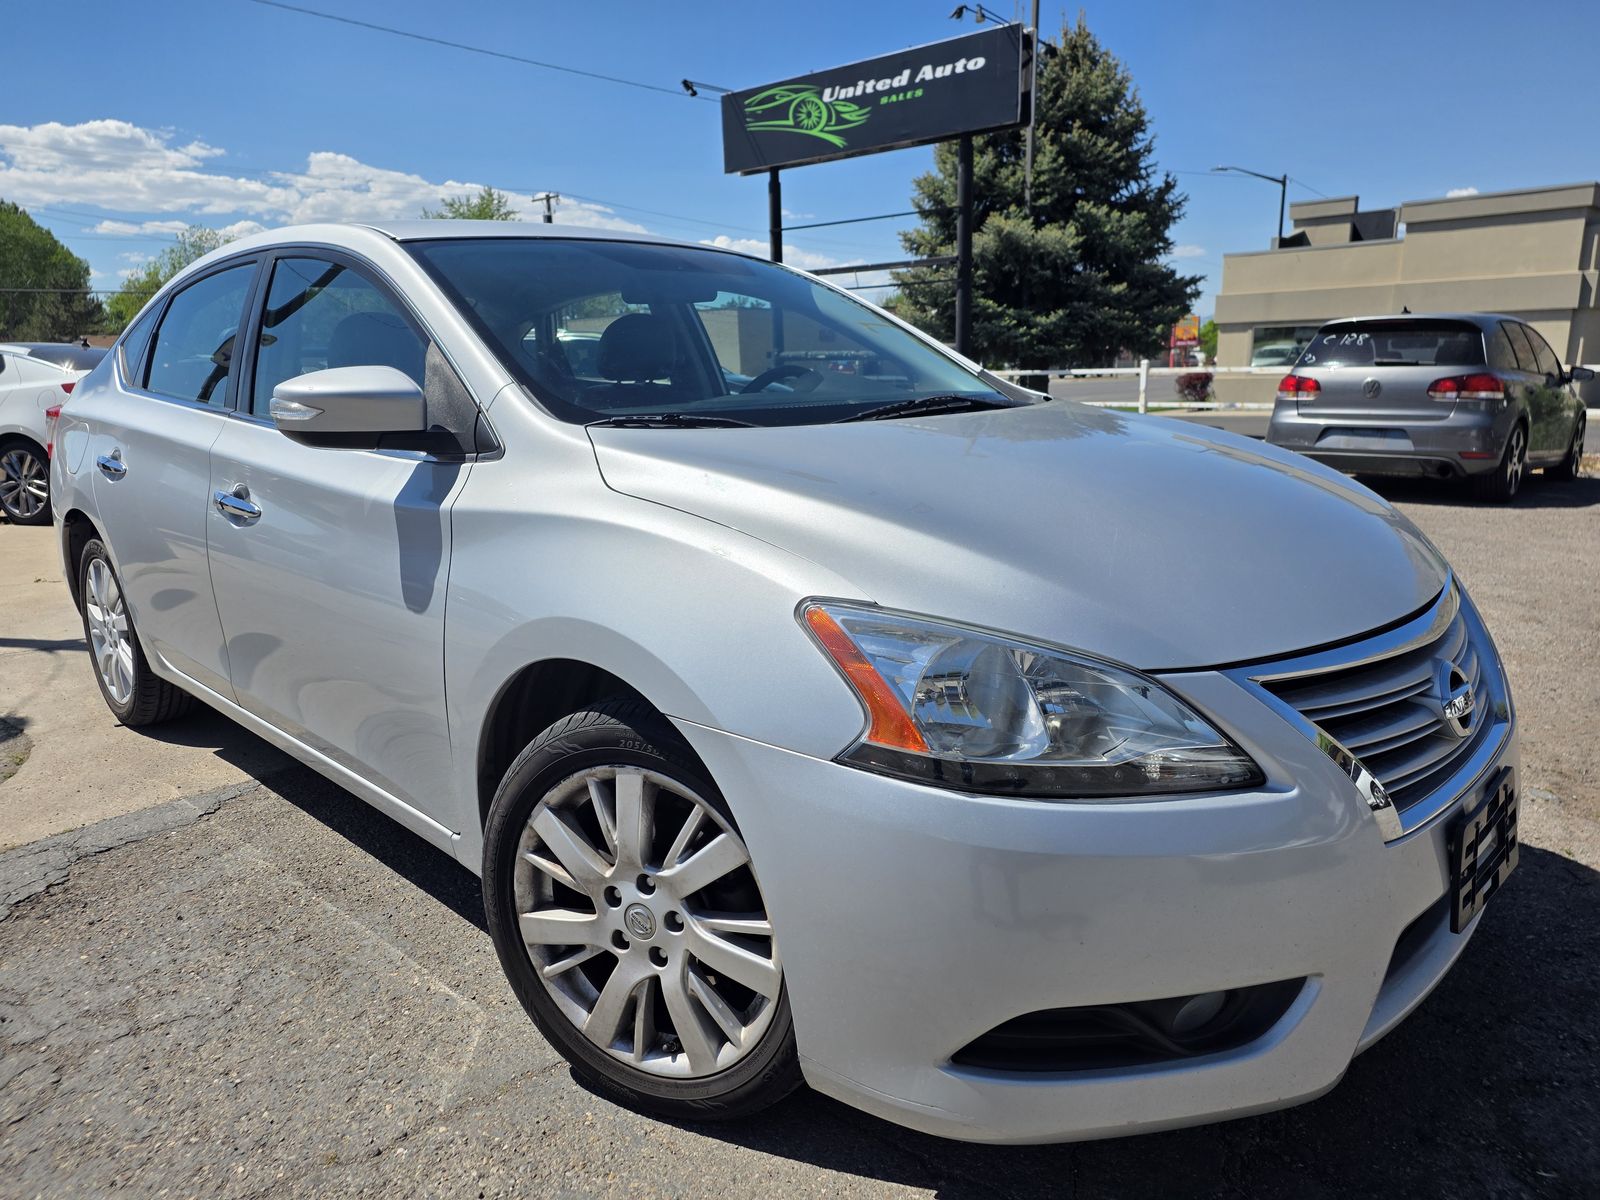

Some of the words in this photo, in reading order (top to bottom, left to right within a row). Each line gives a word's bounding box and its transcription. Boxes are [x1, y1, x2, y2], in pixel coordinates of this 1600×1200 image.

[821, 69, 911, 103] United
[914, 56, 986, 83] Auto
[879, 88, 924, 105] SALES
